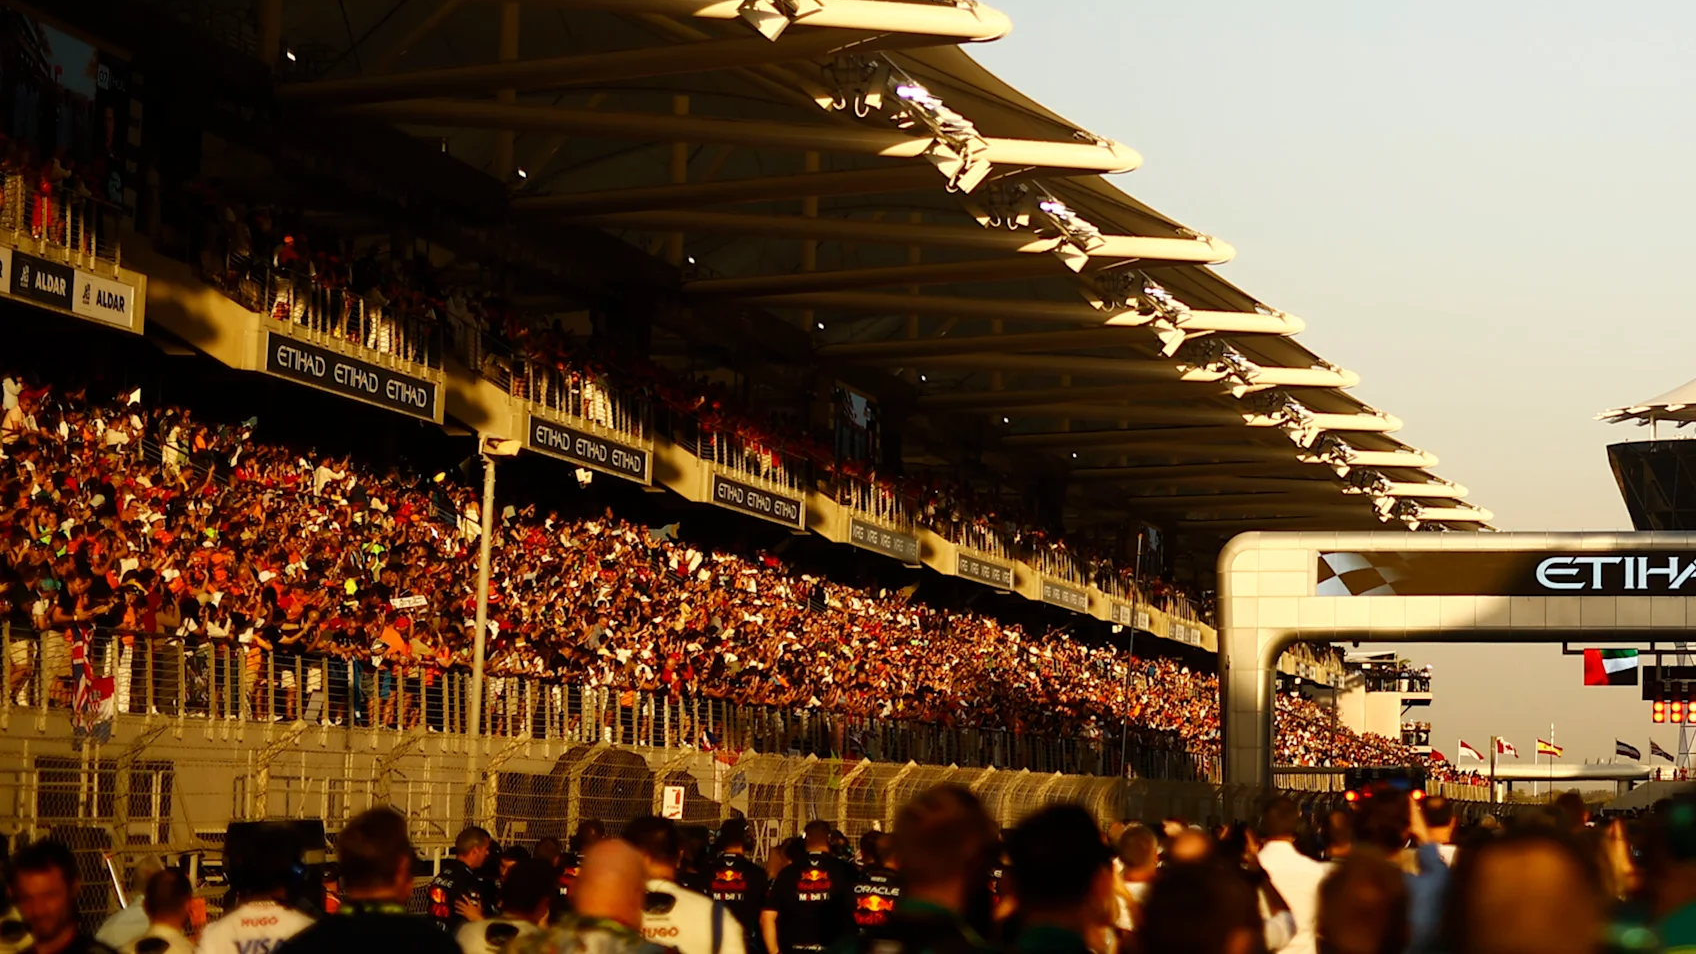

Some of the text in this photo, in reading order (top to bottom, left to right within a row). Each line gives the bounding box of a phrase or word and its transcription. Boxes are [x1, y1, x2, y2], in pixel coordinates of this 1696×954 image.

[35, 271, 67, 297] ALDAR
[96, 290, 125, 314] ALDAR
[276, 345, 427, 408] ETIHAD ETIHAD ETIHAD
[536, 425, 642, 473] ETIHAD ETIHAD ETIHAD
[718, 482, 797, 520] ETIHAD ETIHAD ETIHAD
[854, 884, 900, 897] ORACLE
[241, 916, 279, 927] HUGO
